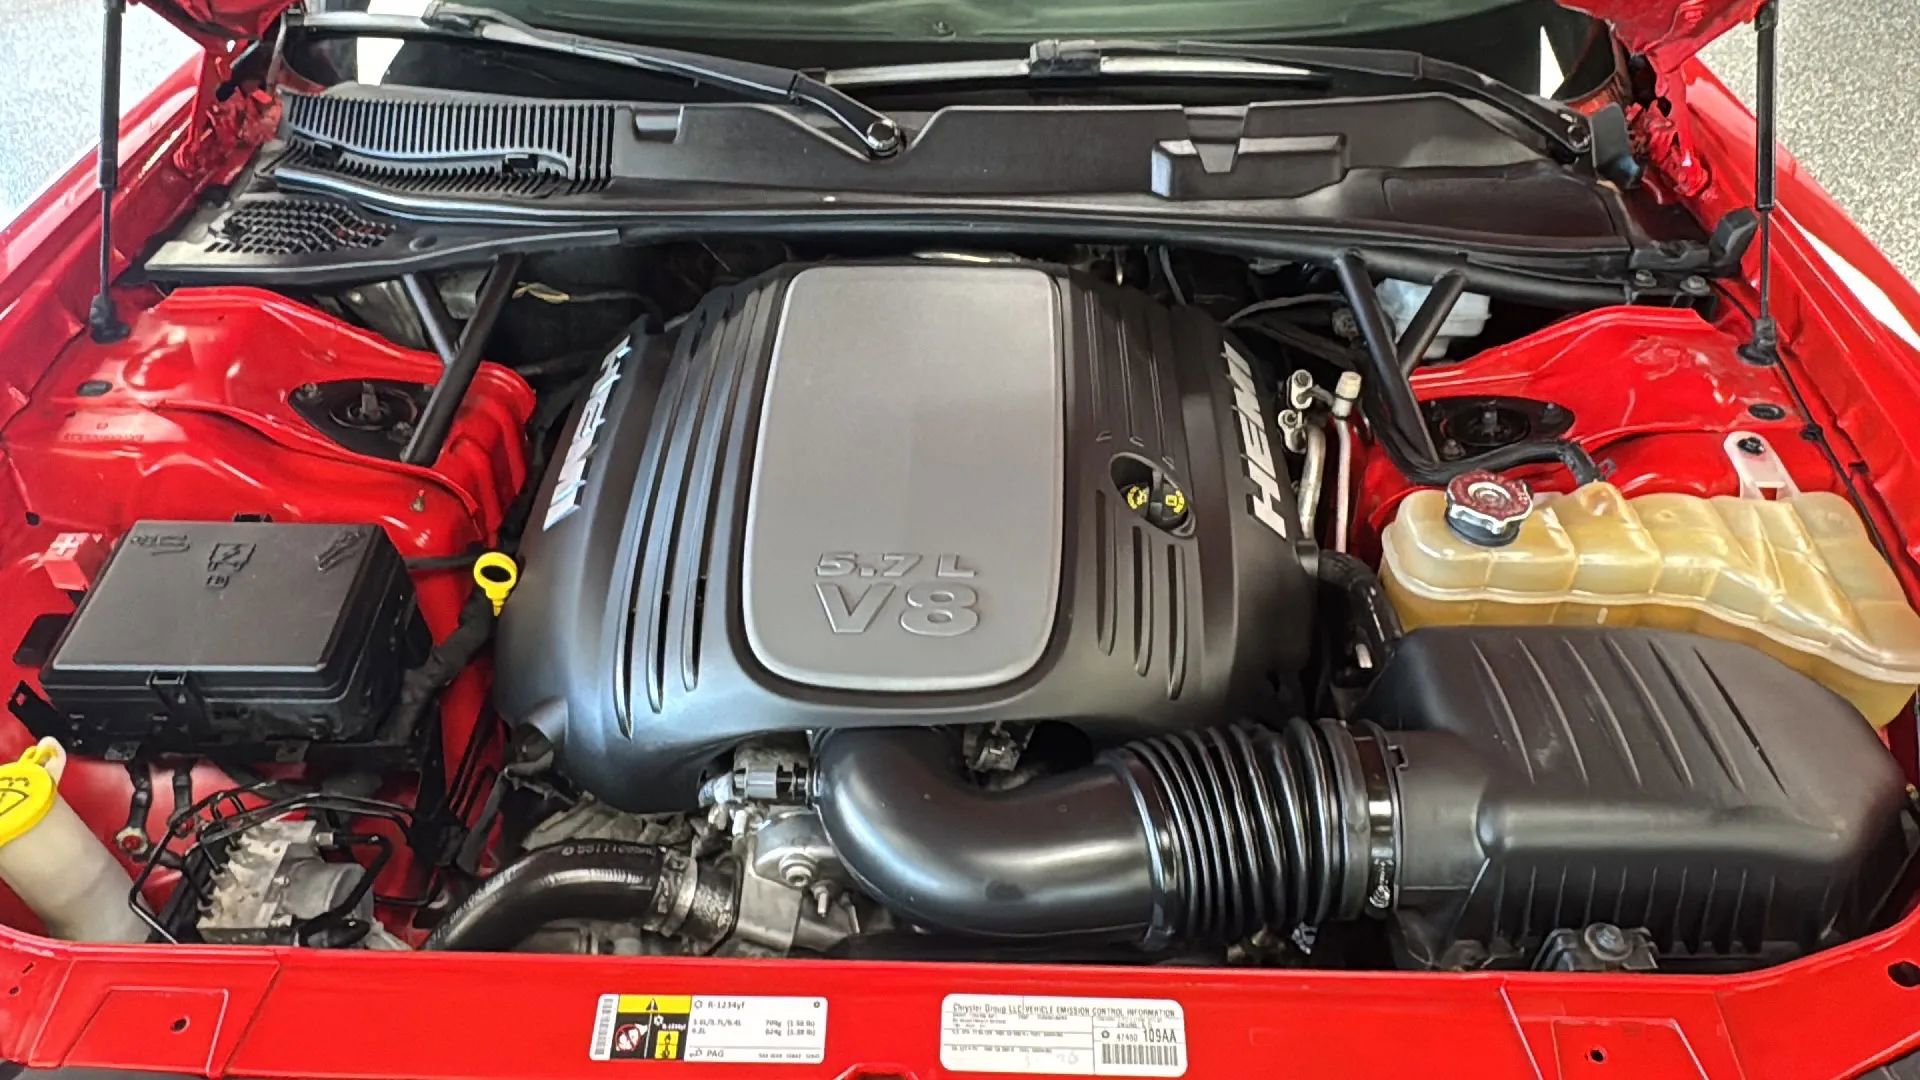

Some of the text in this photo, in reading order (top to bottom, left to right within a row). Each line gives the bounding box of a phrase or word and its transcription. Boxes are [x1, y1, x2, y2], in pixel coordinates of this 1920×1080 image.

[1221, 341, 1287, 539] HEMI
[816, 552, 977, 577] 5.7 L
[815, 582, 980, 636] V8
[985, 1004, 1006, 1015] Group
[1009, 1005, 1022, 1015] LLC
[1026, 1005, 1053, 1015] VEHICLE
[1056, 1006, 1090, 1016] EMISSION
[1092, 1007, 1124, 1017] CONTROL
[1126, 1008, 1175, 1017] INFORMATION
[706, 1050, 724, 1058] PAG
